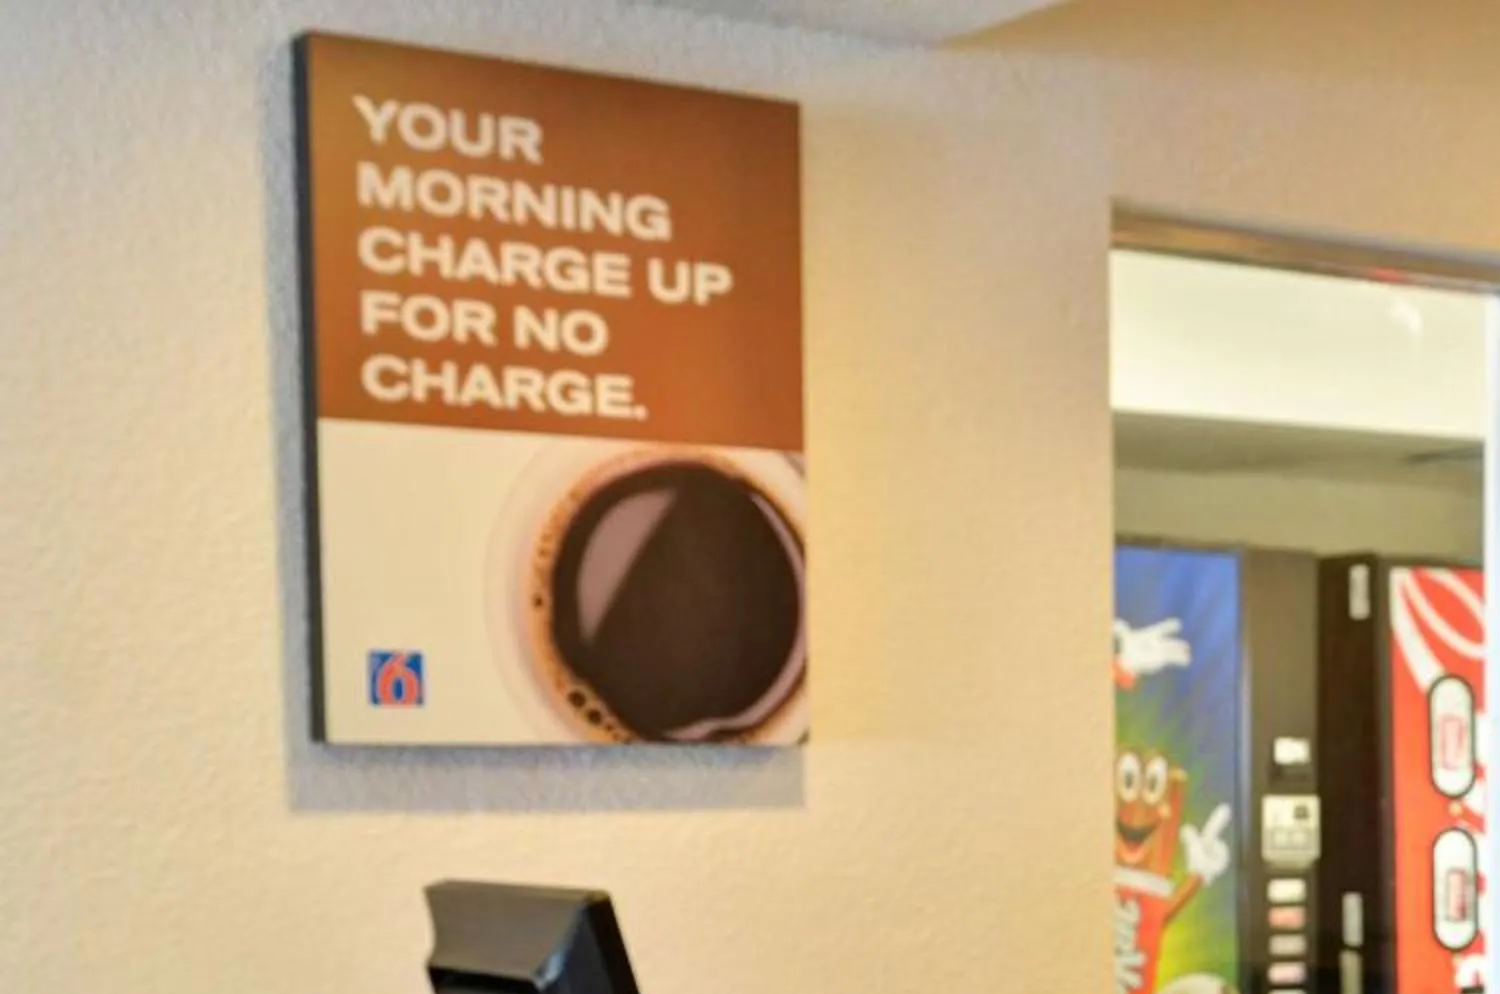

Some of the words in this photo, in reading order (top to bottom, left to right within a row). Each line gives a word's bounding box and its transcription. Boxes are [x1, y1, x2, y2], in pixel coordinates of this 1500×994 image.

[352, 95, 544, 165] YOUR
[357, 160, 672, 241] MORNING
[357, 228, 632, 298] CHARGE
[647, 260, 733, 305] UP
[360, 291, 496, 346] FOR
[513, 306, 608, 356] NO
[361, 355, 647, 420] CHARGE.
[377, 652, 419, 706] 6
